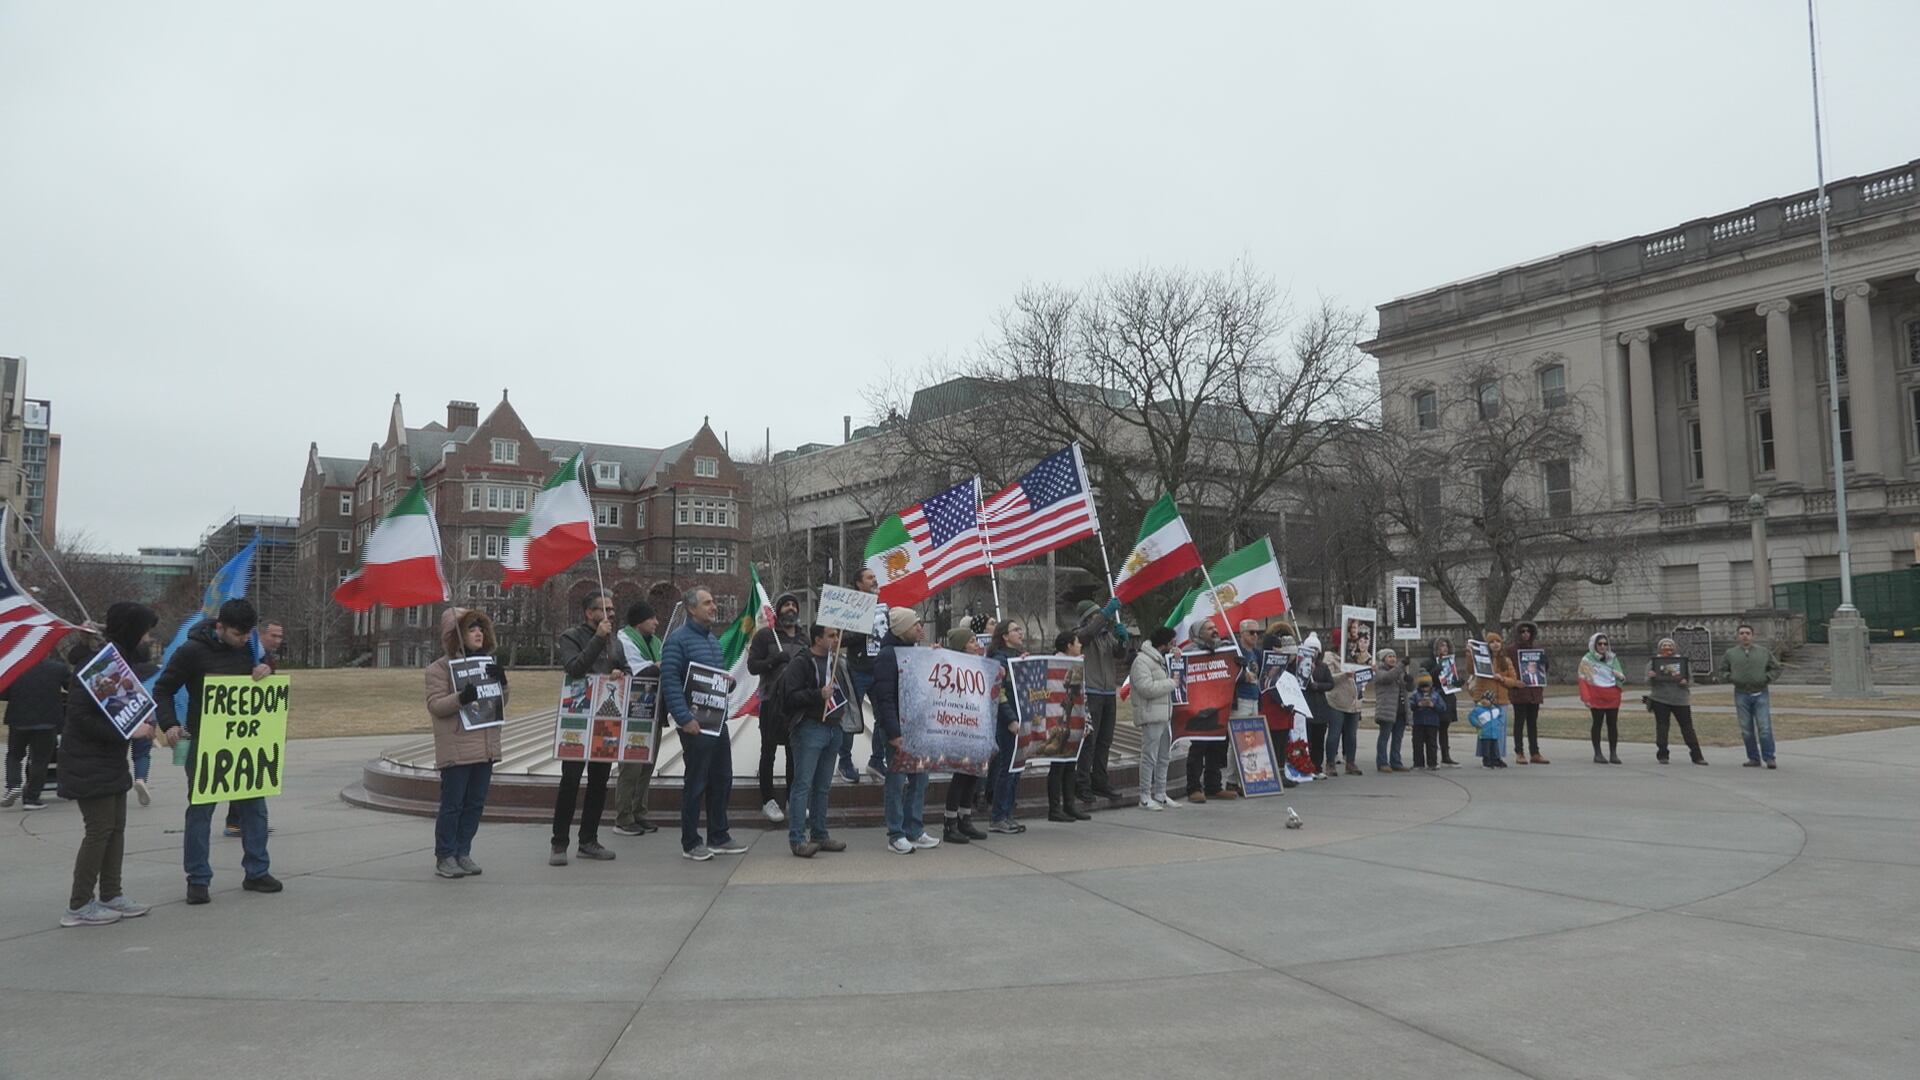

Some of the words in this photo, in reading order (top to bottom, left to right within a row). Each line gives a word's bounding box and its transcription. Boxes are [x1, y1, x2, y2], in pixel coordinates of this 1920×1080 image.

[928, 663, 986, 697] 43,000
[114, 692, 149, 729] MIGA
[204, 684, 289, 716] FREEDOM
[225, 719, 261, 739] FOR
[936, 710, 979, 728] bloodiest
[198, 742, 279, 795] IRAN
